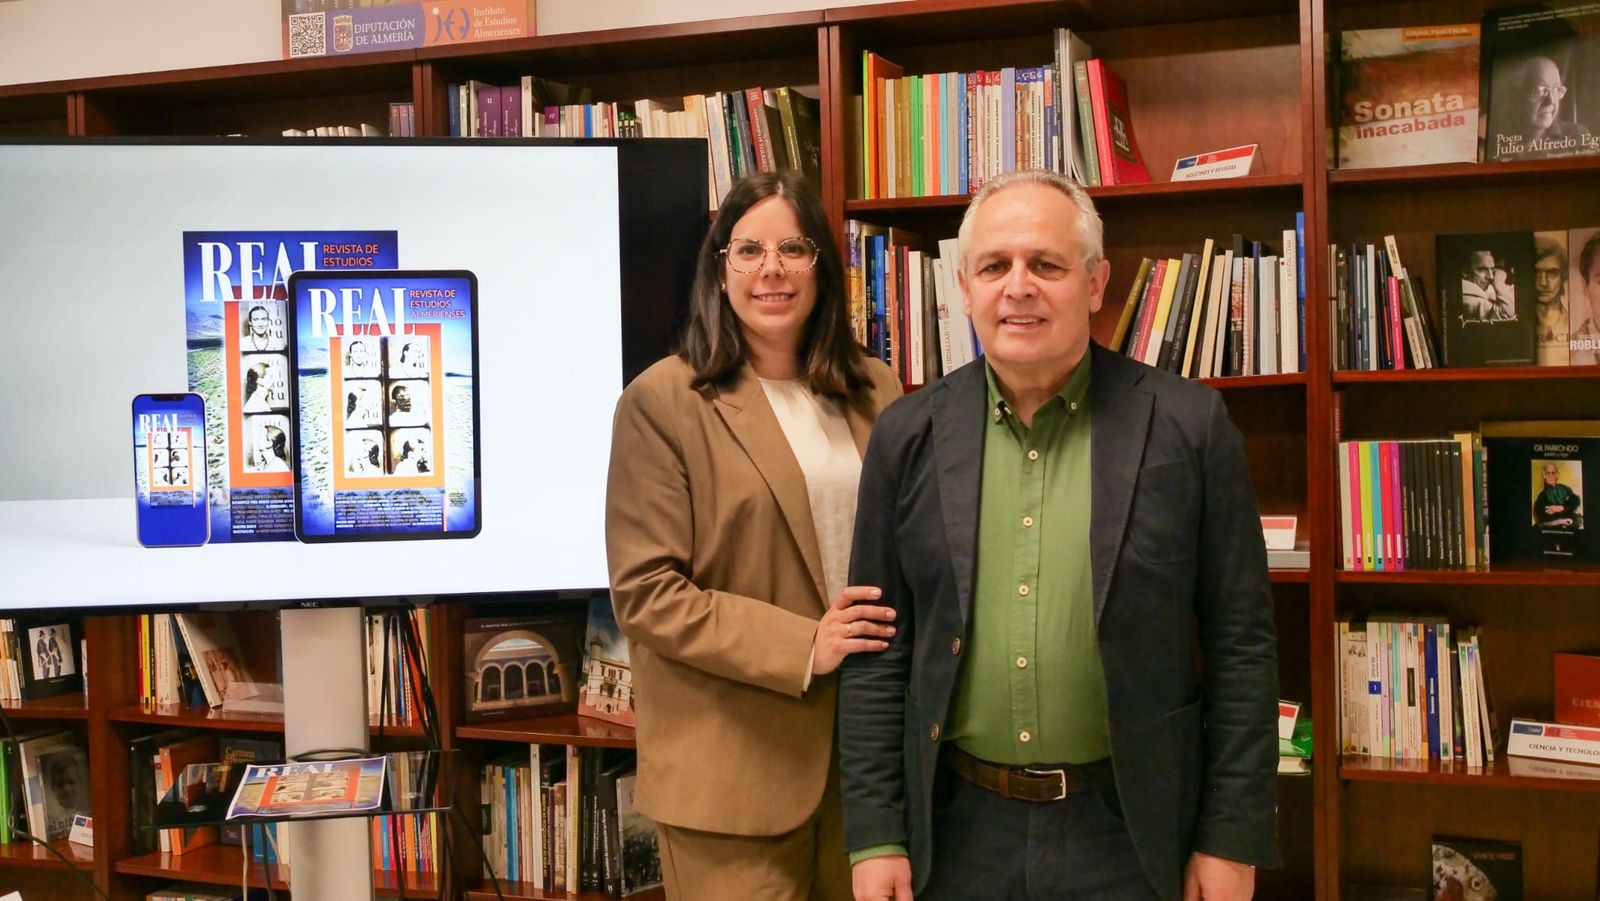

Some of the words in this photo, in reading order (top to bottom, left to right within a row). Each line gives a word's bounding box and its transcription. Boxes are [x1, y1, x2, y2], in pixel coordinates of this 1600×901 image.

[473, 7, 506, 16] Instituto
[354, 18, 416, 34] DIPUTACIÓN
[474, 18, 482, 27] de
[484, 16, 518, 26] Estudios
[474, 26, 520, 38] Almerienses
[356, 36, 368, 46] DE
[370, 32, 415, 44] ALMERÍA
[1354, 92, 1464, 122] Sonata
[1356, 113, 1466, 139] inacabada
[1496, 134, 1522, 143] Poeta
[1494, 142, 1524, 158] Julio
[1528, 136, 1576, 152] Alfredo
[323, 244, 364, 254] REVISTA
[365, 244, 378, 254] DE
[323, 258, 373, 266] ESTUDIOS
[410, 300, 450, 308] ESTUDIOS
[308, 288, 416, 337] REAL
[410, 290, 442, 298] REVISTA
[410, 310, 466, 319] ALMERIENSES
[139, 413, 182, 432] REAL
[1529, 743, 1556, 751] CIENCIA
[1566, 747, 1600, 756] TECNOLO
[256, 763, 340, 778] REAL
